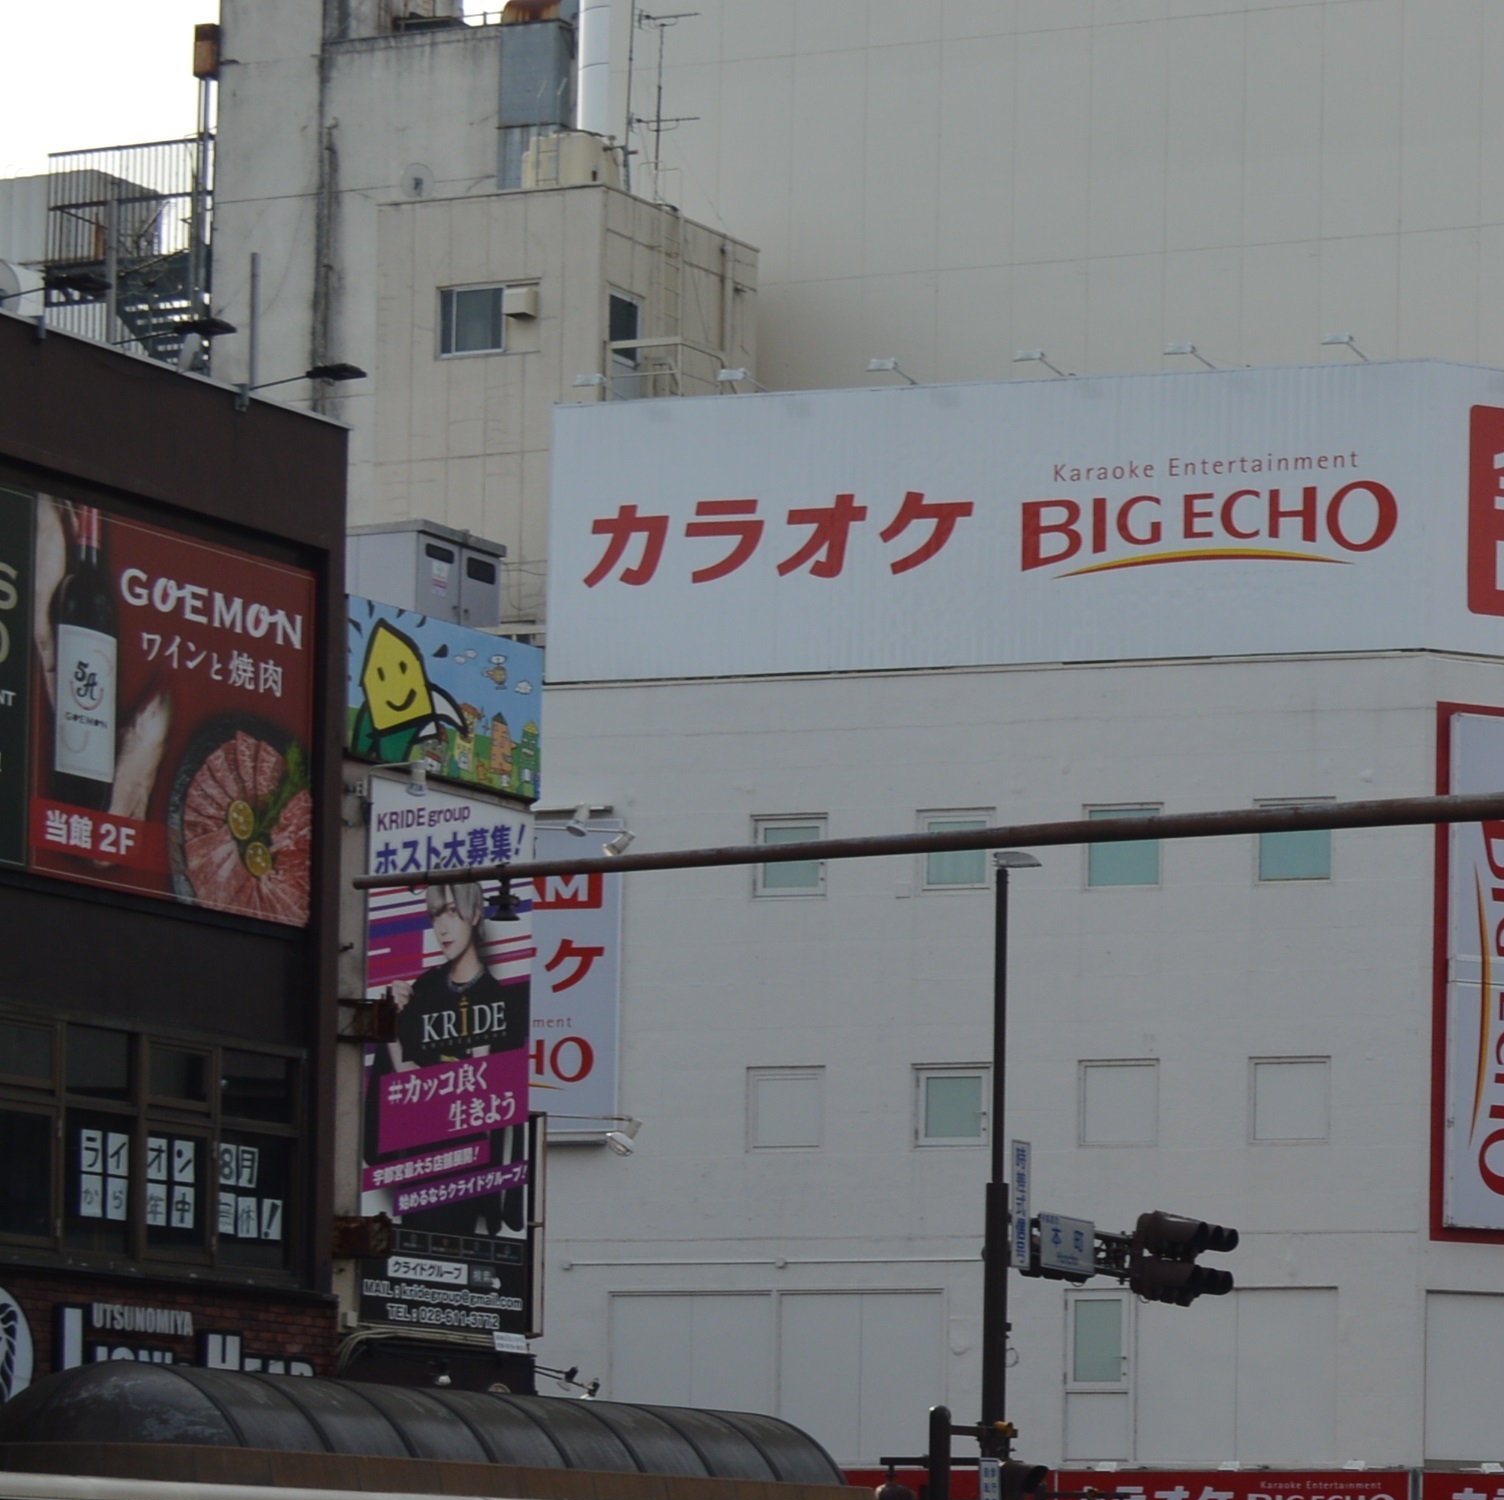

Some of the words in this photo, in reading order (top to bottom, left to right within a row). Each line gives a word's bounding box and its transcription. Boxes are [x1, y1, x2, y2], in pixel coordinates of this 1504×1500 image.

[1054, 460, 1154, 483] Karaoke
[1168, 450, 1359, 477] Entertainment
[583, 491, 974, 588] カラオケ
[1021, 496, 1163, 572] BIG
[1182, 480, 1398, 553] ECHO
[120, 568, 303, 650] GOEMON
[141, 632, 285, 698] ワインと焼肉
[45, 808, 92, 848] 当館
[99, 822, 136, 856] 2F
[377, 808, 426, 832] KRIDE
[428, 805, 471, 827] group
[448, 1091, 517, 1133] 生きよう
[391, 1259, 463, 1281] クライドグループ
[93, 1302, 194, 1337] UTSUNOMIYA
[1260, 1480, 1303, 1490] Karaoke
[1305, 1480, 1382, 1490] Entertainment
